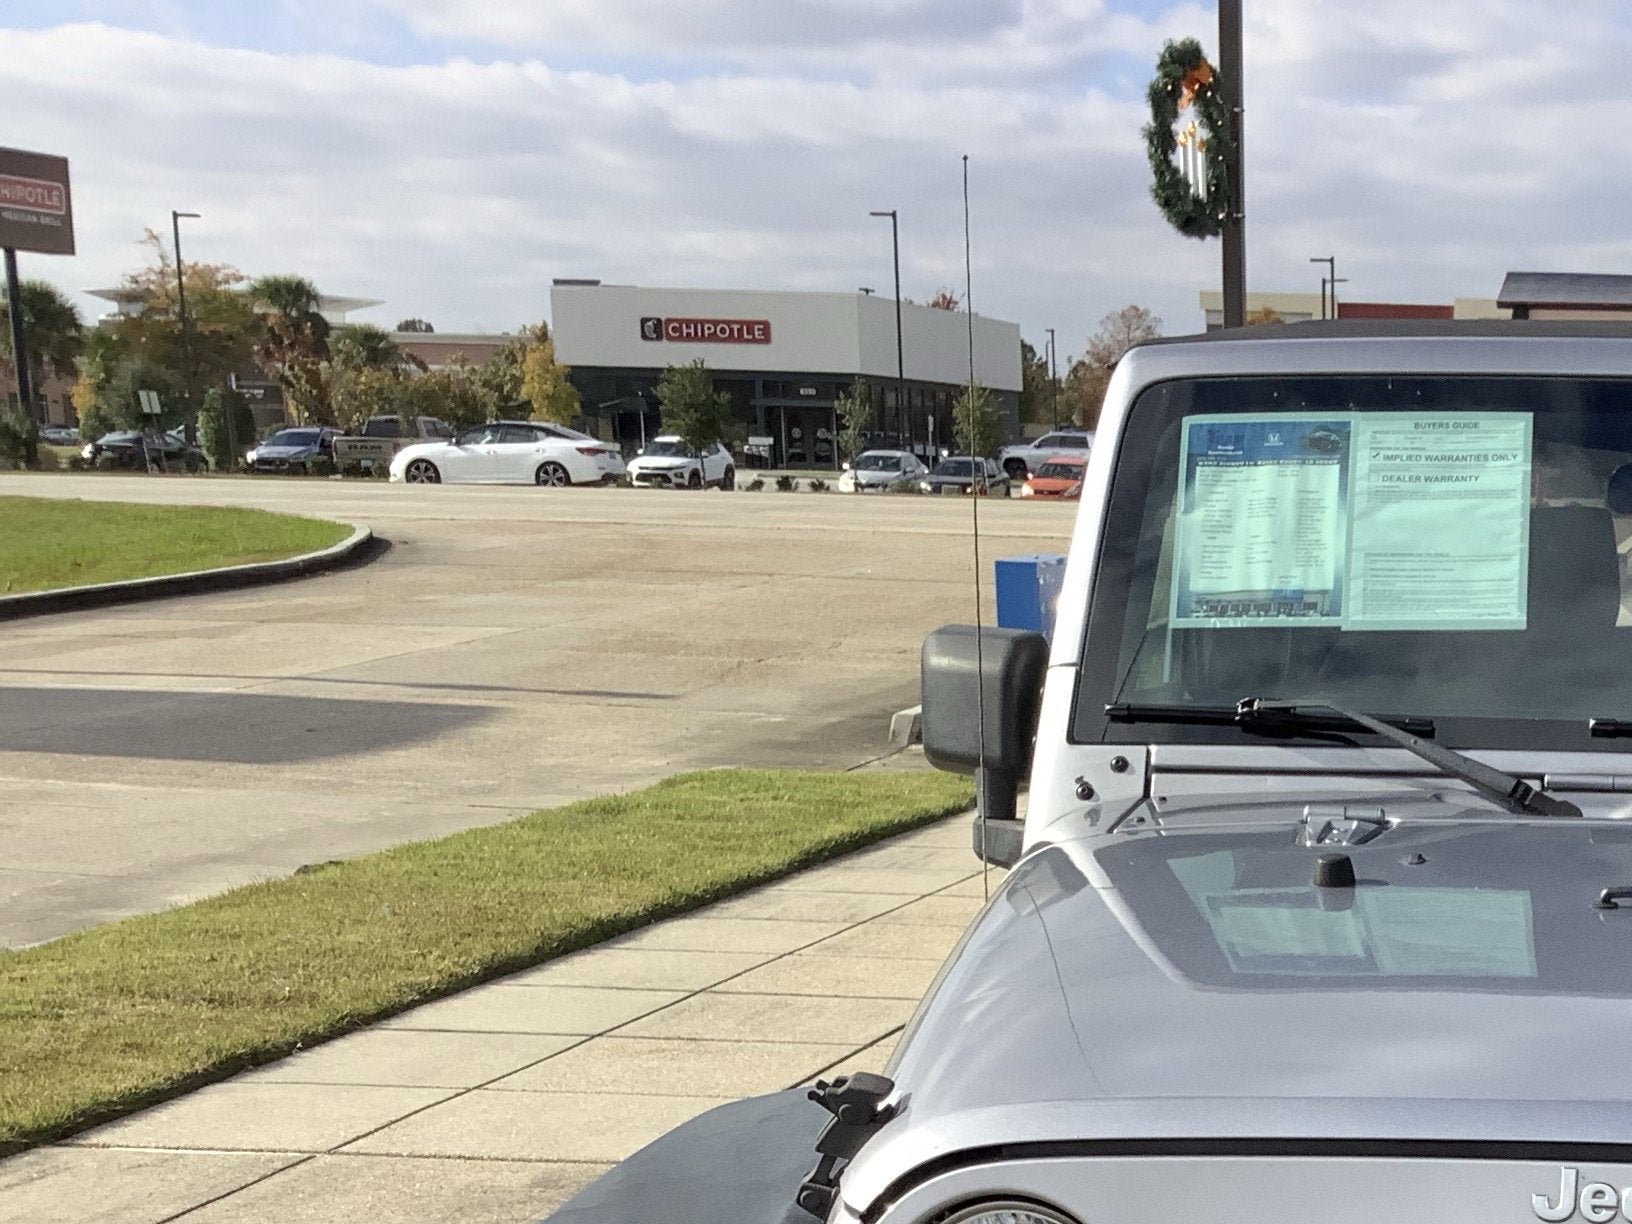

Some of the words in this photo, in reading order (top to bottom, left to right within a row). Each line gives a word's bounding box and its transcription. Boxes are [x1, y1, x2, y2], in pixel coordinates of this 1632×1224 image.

[0, 183, 61, 206] HIPOTLE
[668, 322, 765, 339] CHIPOTLE
[1414, 422, 1450, 430] BUYERS
[1452, 421, 1480, 429] GUIDE
[1383, 454, 1422, 462] IMPLIED
[1425, 454, 1489, 462] WARRANTIES
[1491, 453, 1518, 462] ONLY
[1382, 475, 1421, 483] DEALER
[1424, 475, 1480, 483] WARRANTY
